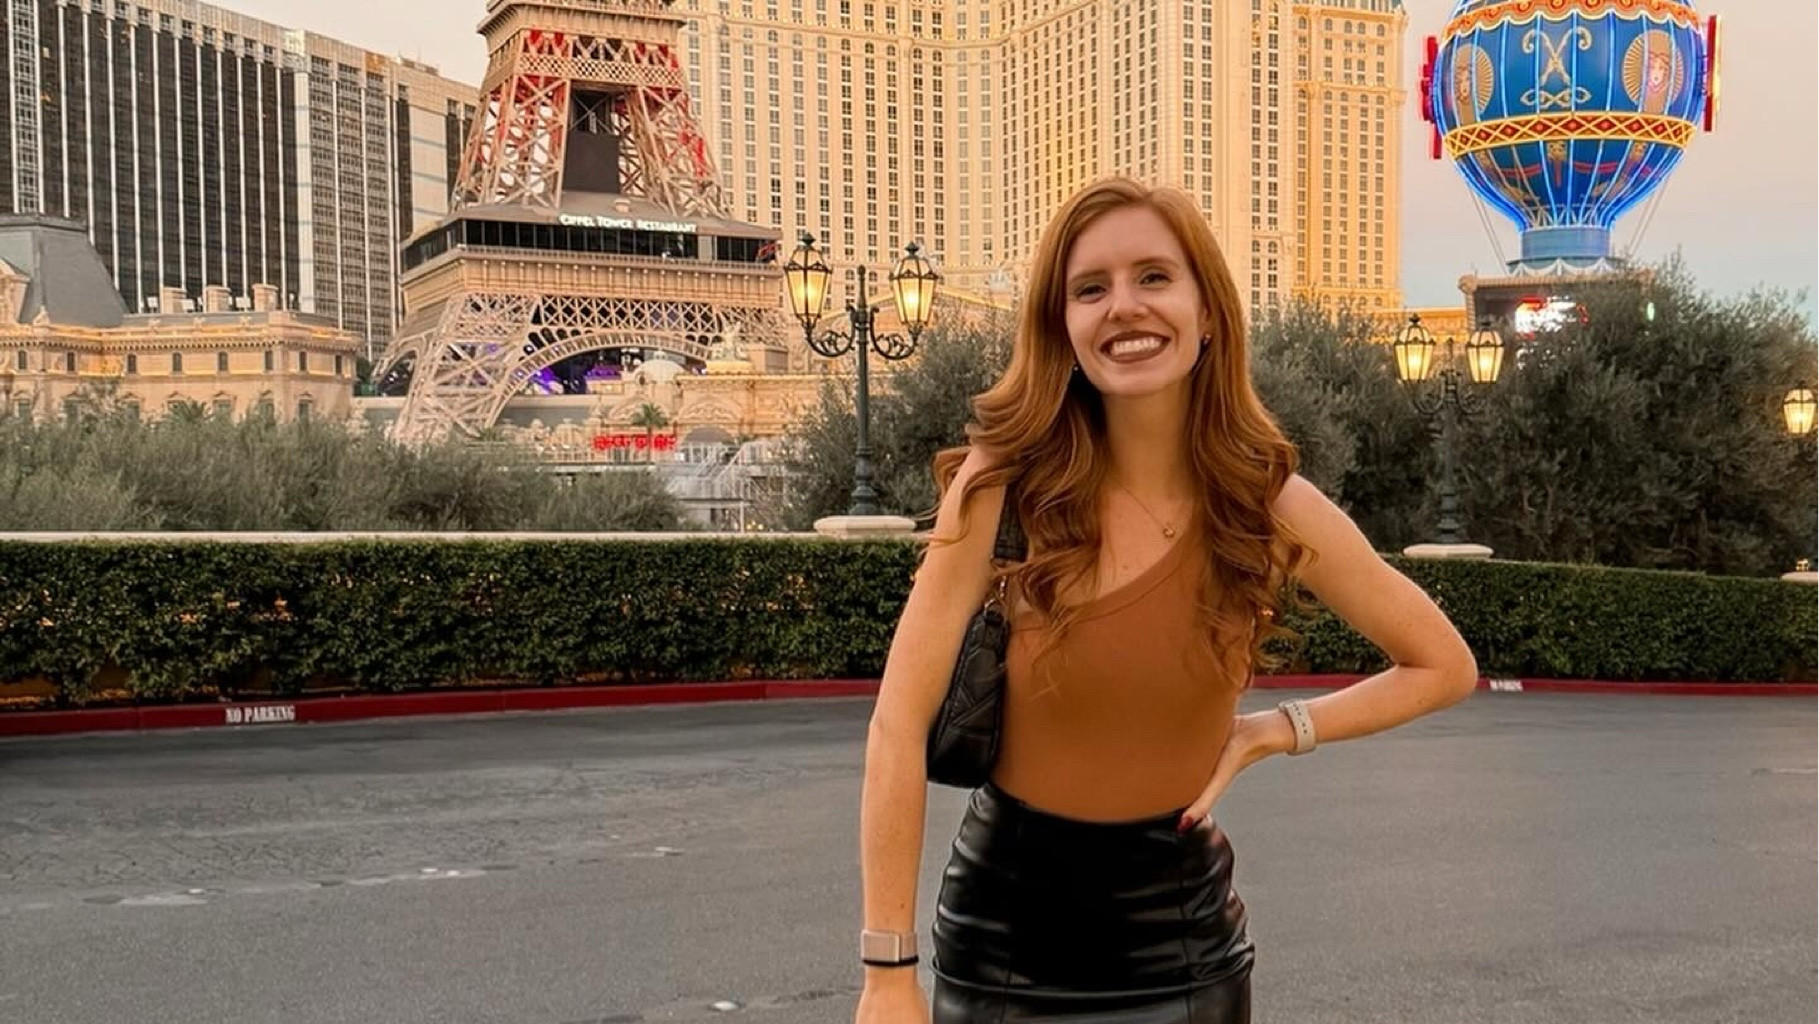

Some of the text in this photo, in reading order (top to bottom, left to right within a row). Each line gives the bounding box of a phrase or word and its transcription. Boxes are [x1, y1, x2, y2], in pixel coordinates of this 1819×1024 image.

[596, 215, 634, 229] TOWER
[636, 218, 697, 233] RESTAURANT
[225, 705, 296, 723] NO PARKING
